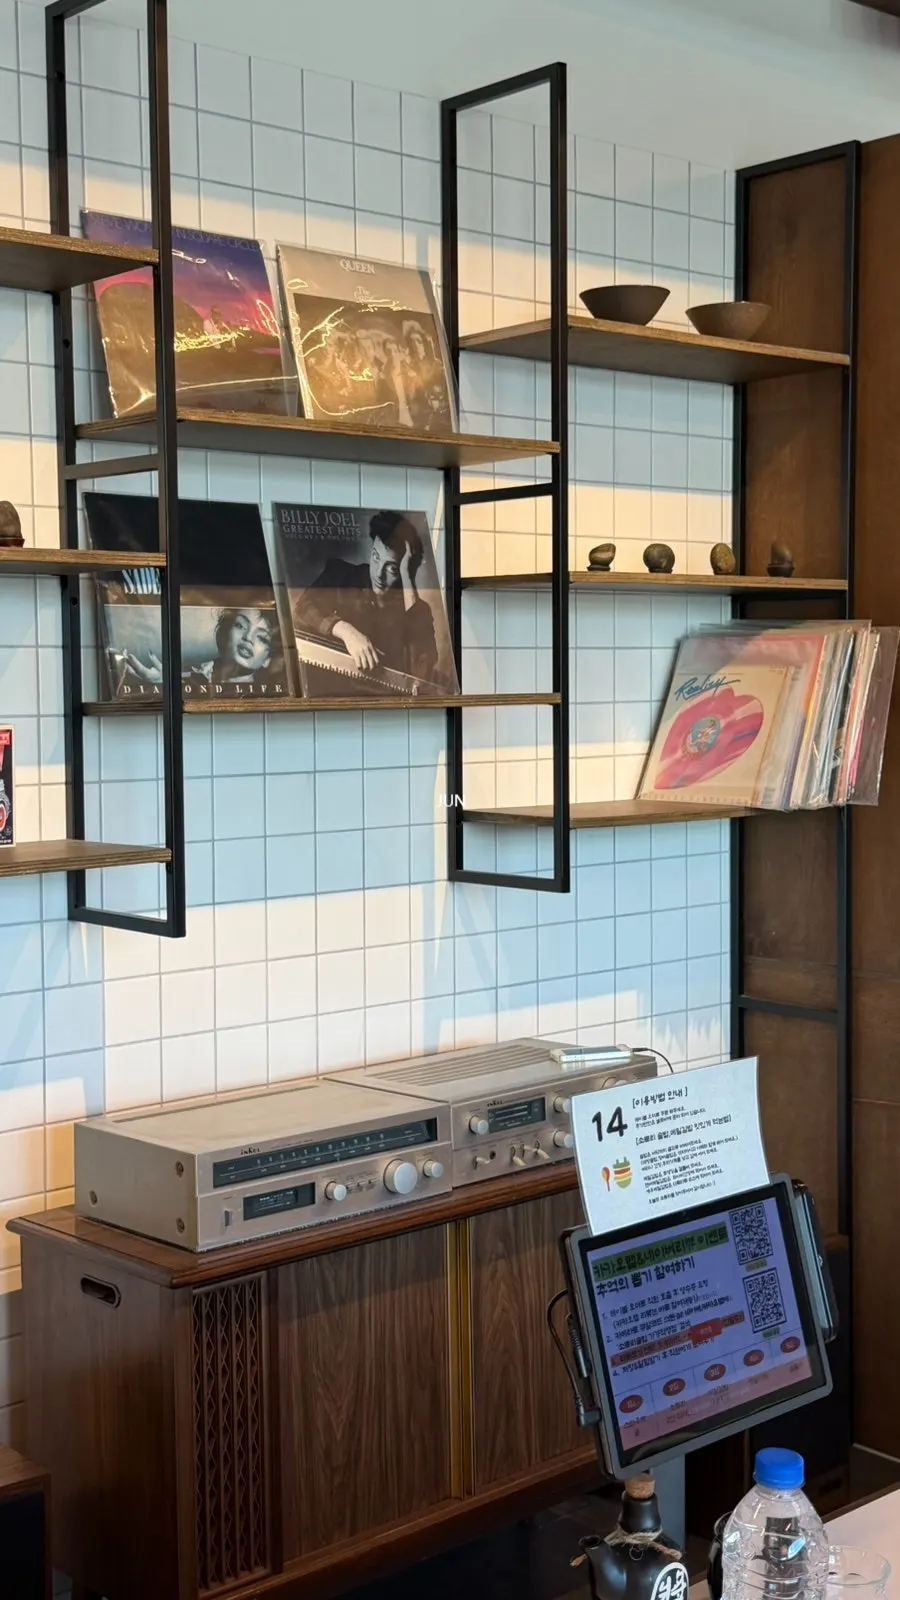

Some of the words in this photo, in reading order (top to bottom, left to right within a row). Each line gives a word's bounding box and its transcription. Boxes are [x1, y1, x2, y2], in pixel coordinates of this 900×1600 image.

[340, 259, 376, 274] QUEEN
[280, 509, 319, 525] BILLY
[324, 511, 360, 527] JOEL
[282, 524, 335, 535] GREATEST
[337, 527, 361, 537] HITS
[124, 684, 223, 695] DIAOND
[236, 684, 283, 695] LIFE
[631, 1091, 665, 1109] [이용방법
[590, 1103, 629, 1143] 14
[595, 1275, 629, 1299] 추억의
[630, 1268, 653, 1288] 뽑기
[653, 1255, 695, 1281] 참여하기
